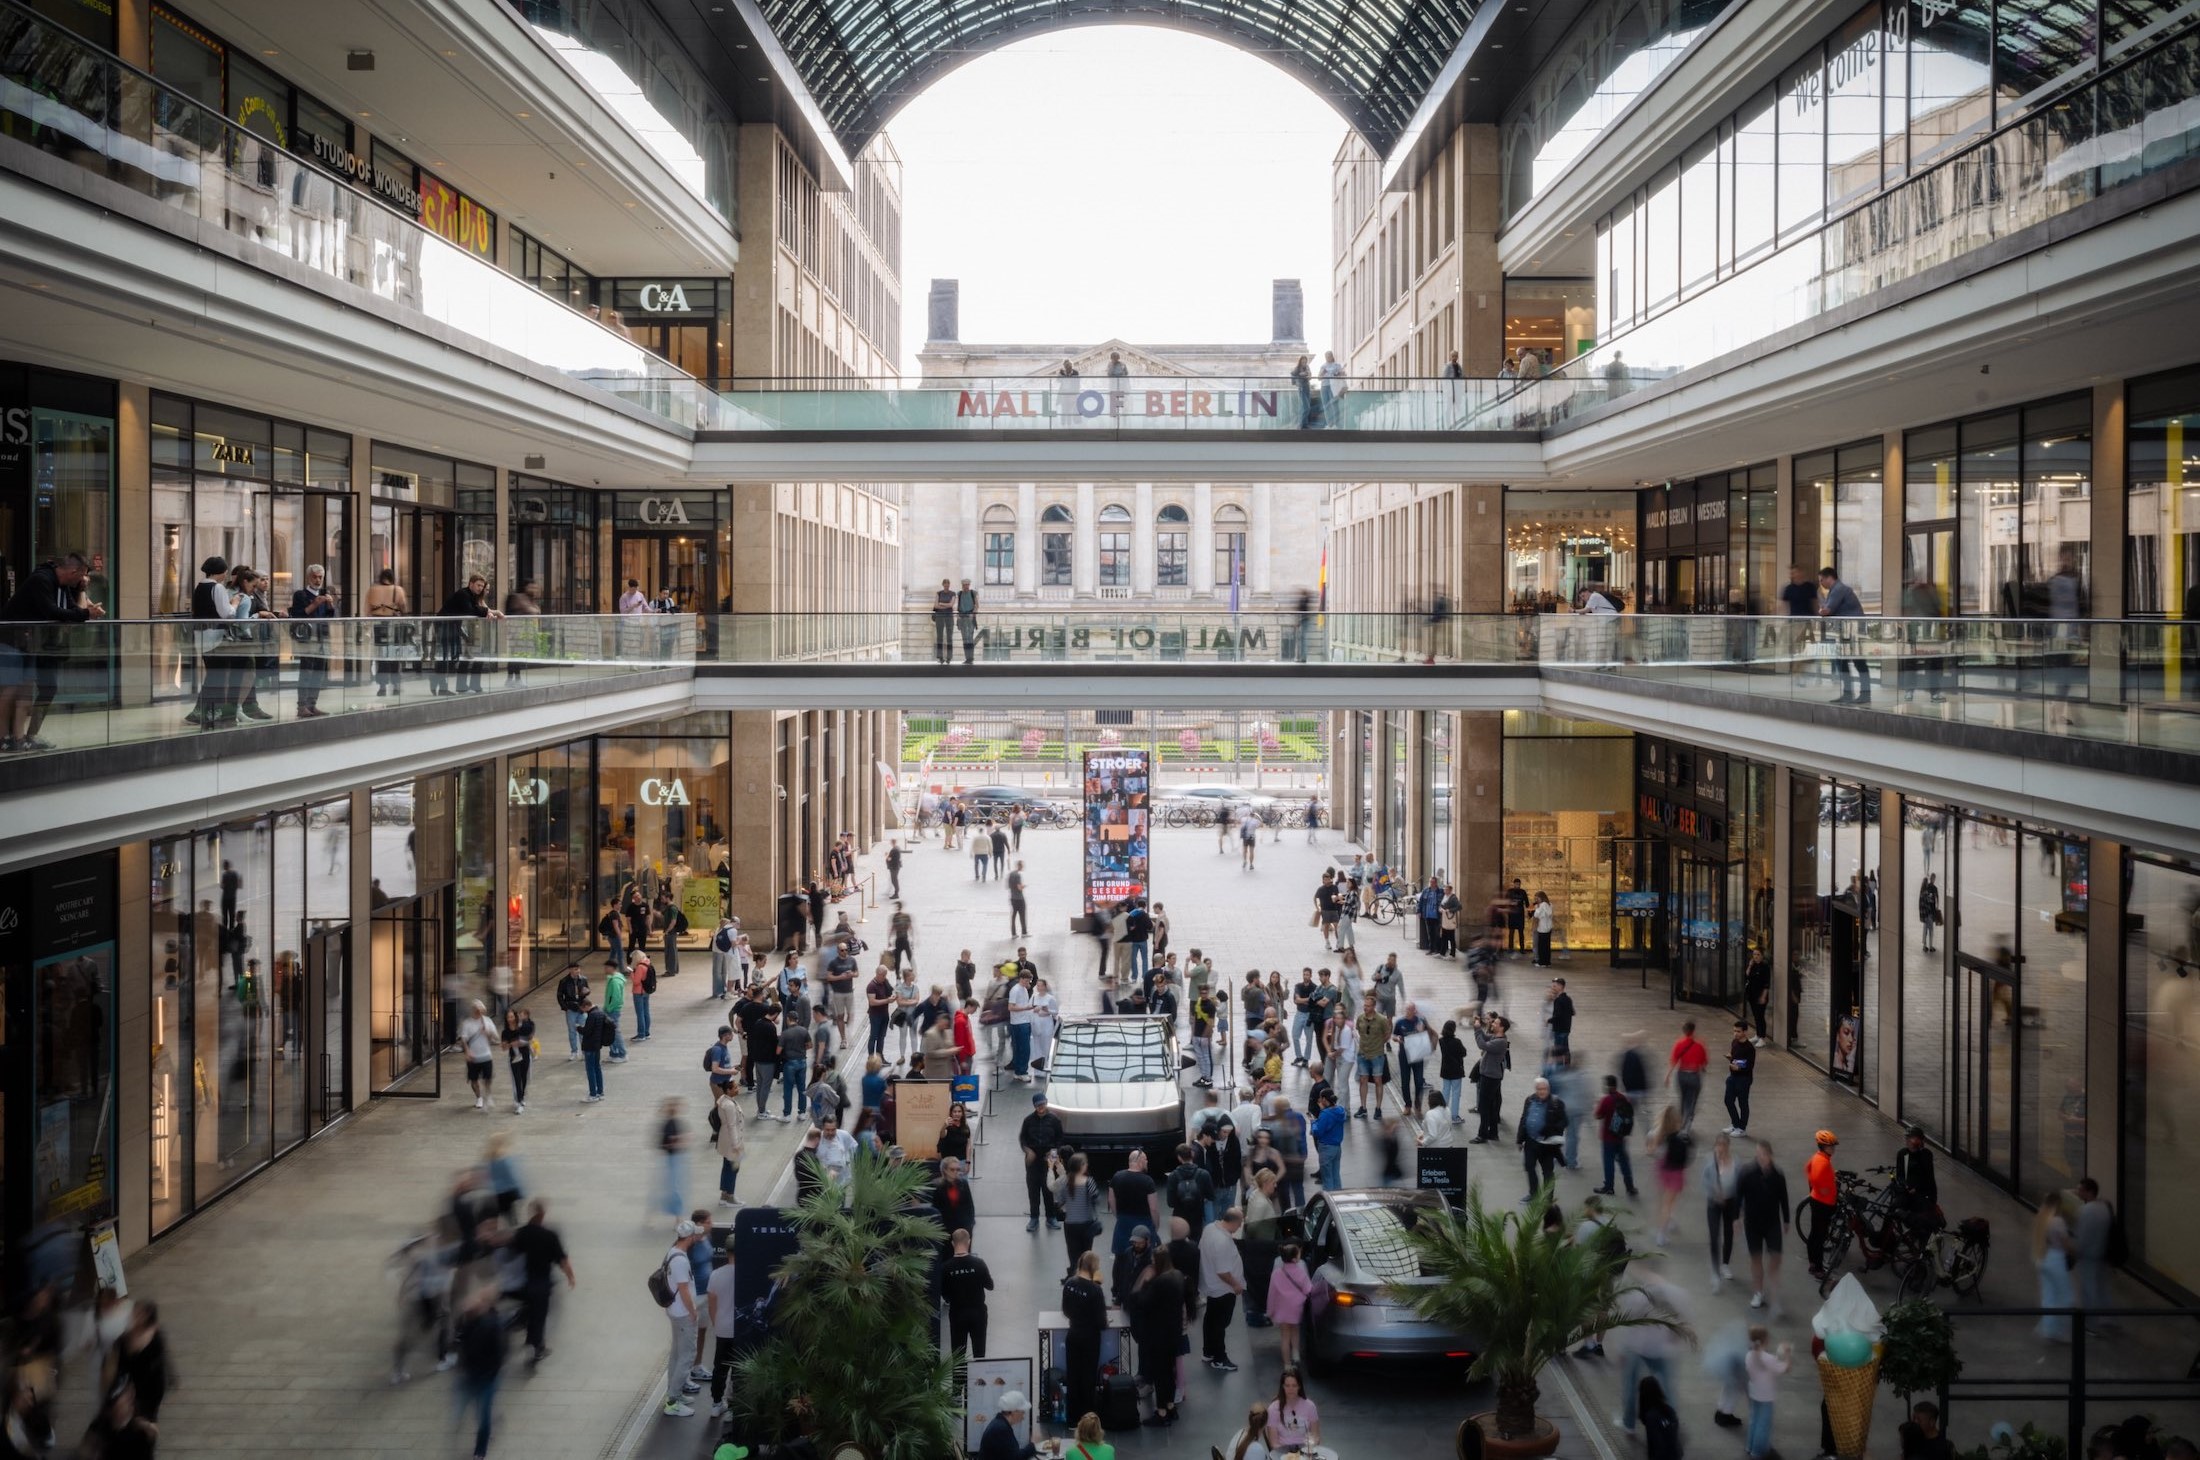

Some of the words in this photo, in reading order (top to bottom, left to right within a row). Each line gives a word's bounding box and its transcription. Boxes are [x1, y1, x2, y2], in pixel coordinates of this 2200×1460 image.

[1888, 5, 1908, 52] to
[314, 134, 356, 174] STUDIO
[357, 158, 373, 184] OF
[374, 168, 423, 211] WONDERS
[640, 284, 691, 311] C&A
[957, 390, 1058, 418] MALL
[1077, 389, 1126, 419] OF
[1145, 390, 1278, 418] BERLIN
[211, 443, 255, 465] ZARA
[639, 497, 690, 525] C&A
[1646, 512, 1660, 529] MALL
[1669, 506, 1688, 526] BERLIN
[1697, 500, 1726, 521] WESTSIDE
[640, 778, 691, 806] C&A
[1679, 807, 1712, 842] BERLIN
[685, 895, 718, 908] -50%
[1092, 887, 1130, 895] GESETZ
[1421, 1168, 1447, 1177] Erleben
[752, 1226, 796, 1234] TESLA
